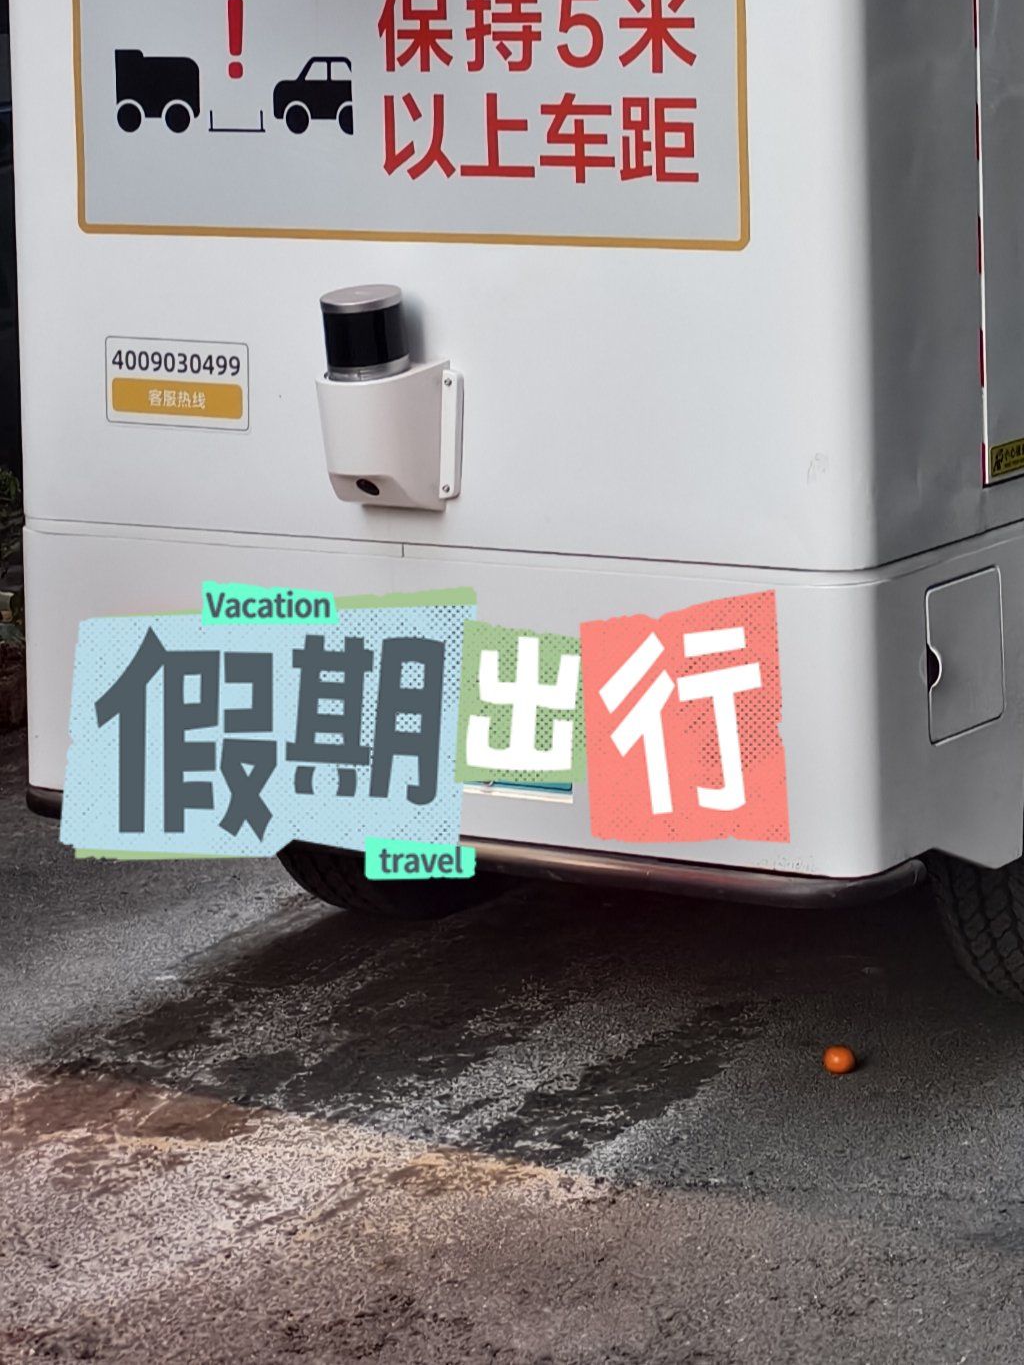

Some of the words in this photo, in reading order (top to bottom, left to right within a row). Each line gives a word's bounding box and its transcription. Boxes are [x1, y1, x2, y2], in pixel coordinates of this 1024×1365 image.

[382, 92, 700, 184] 以上车距
[111, 350, 241, 376] 4009030499
[148, 389, 206, 410] 客服热线
